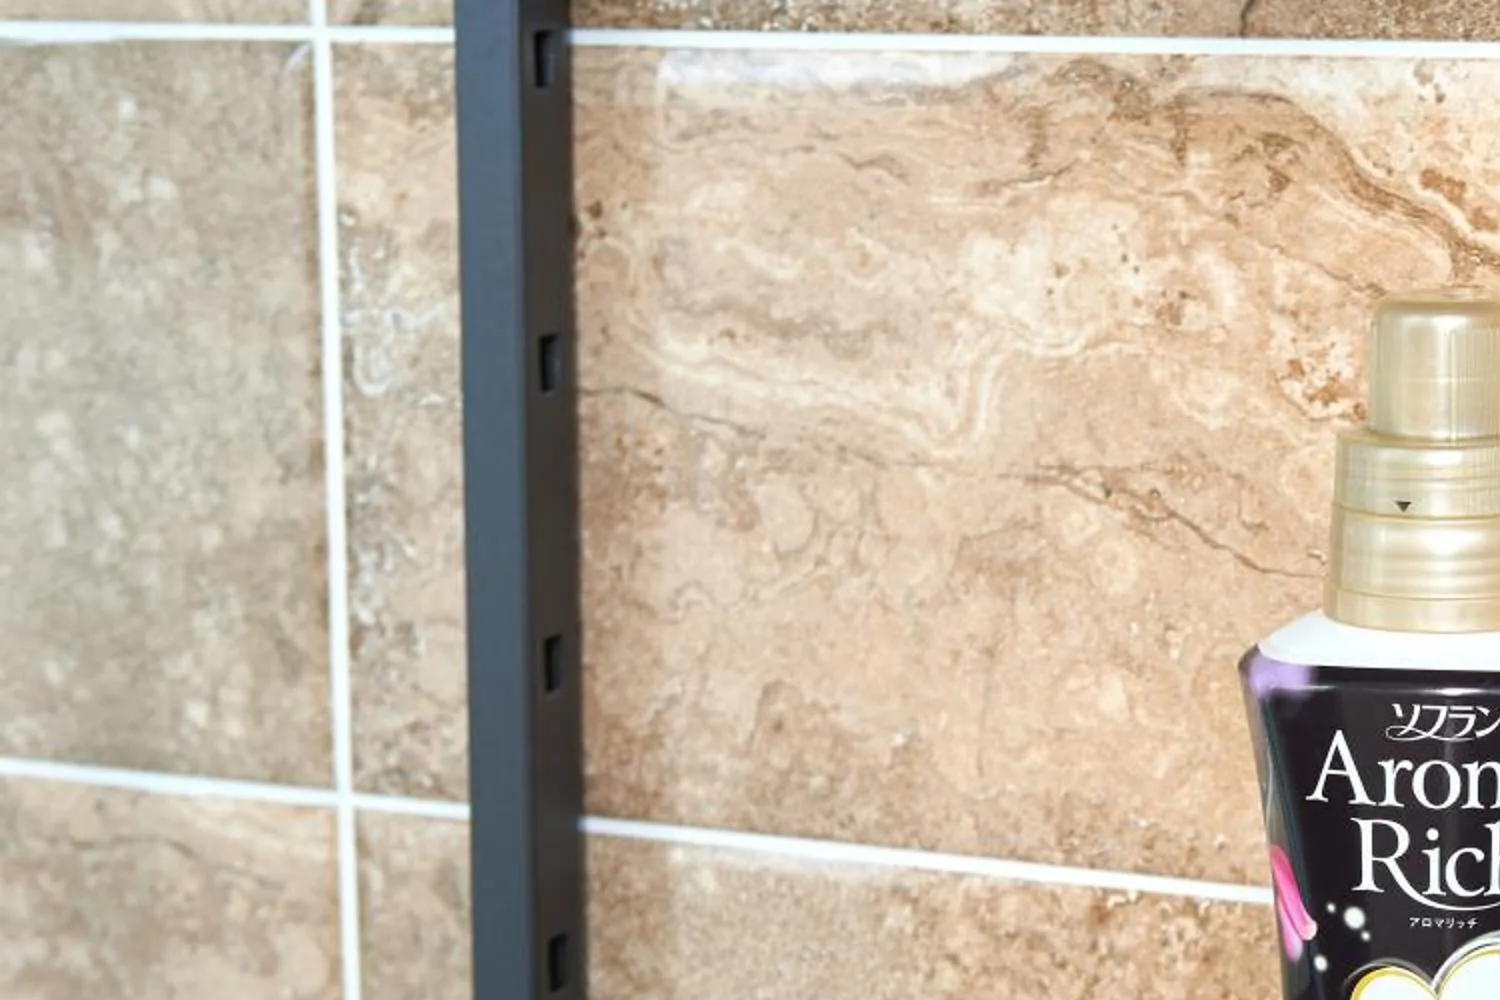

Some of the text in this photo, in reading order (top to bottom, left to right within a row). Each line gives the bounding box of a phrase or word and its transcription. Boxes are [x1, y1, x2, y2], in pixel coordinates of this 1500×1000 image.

[1409, 916, 1479, 929] アロマリッチ
